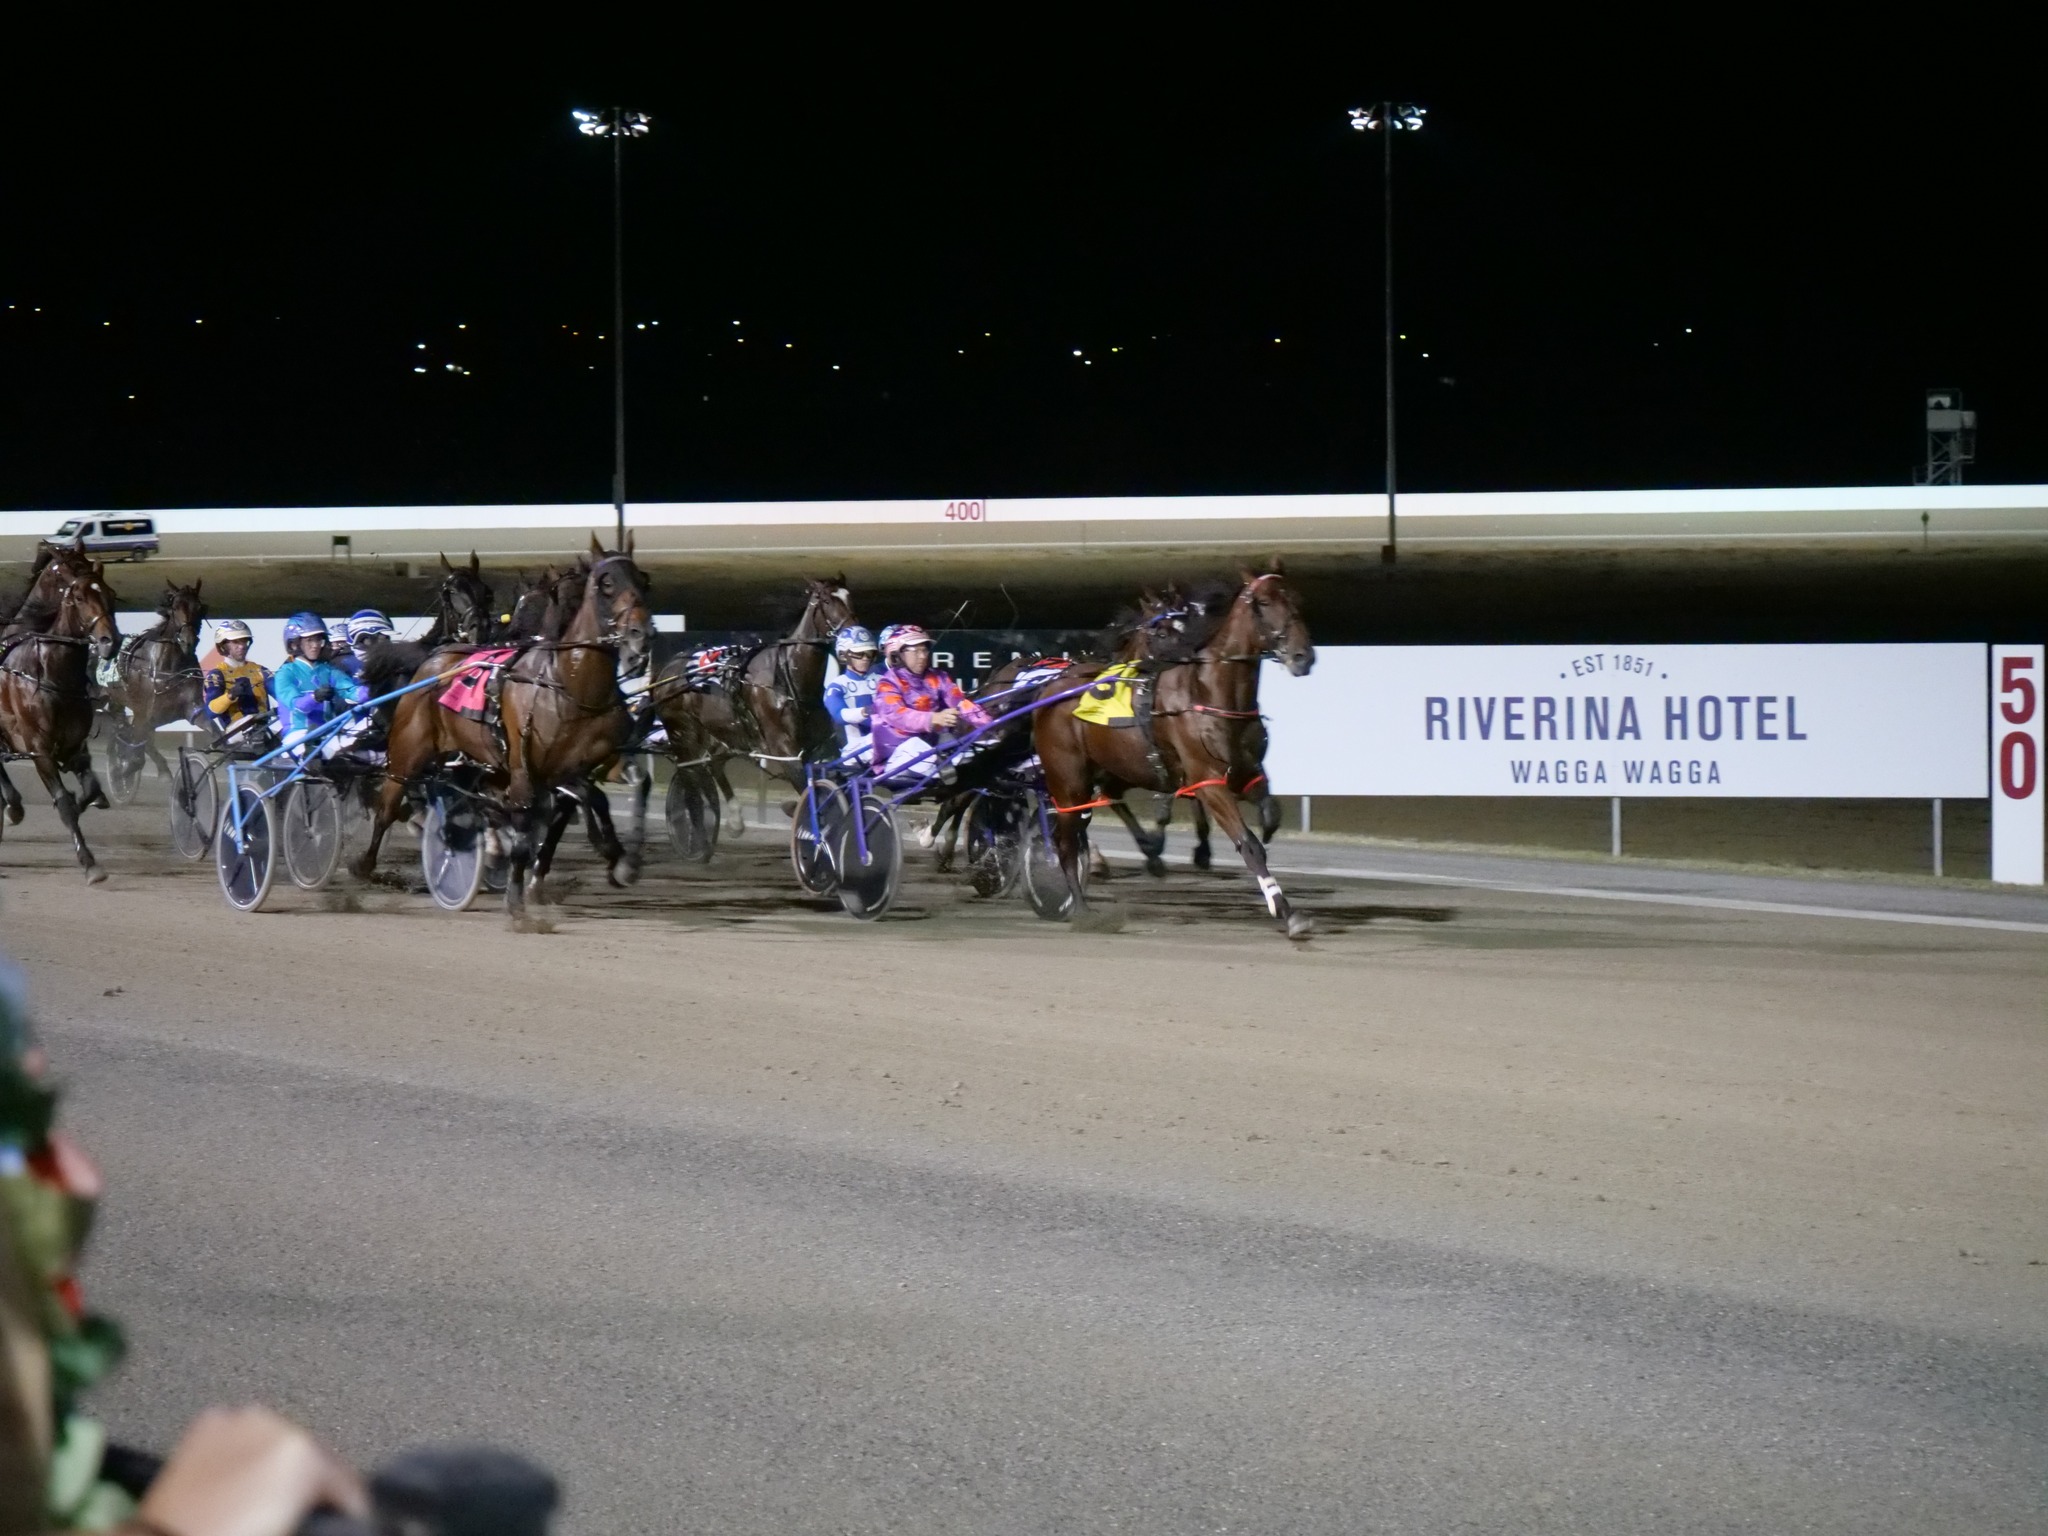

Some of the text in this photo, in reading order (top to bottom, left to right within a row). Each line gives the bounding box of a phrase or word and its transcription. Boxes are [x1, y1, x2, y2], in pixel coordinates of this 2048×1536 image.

[945, 501, 981, 521] 400
[1572, 654, 1654, 677] EST 1851
[1425, 695, 1807, 741] RIVERINA HOTEL
[1999, 656, 2037, 800] 50
[1511, 760, 1720, 784] WAGGA WAGGA
